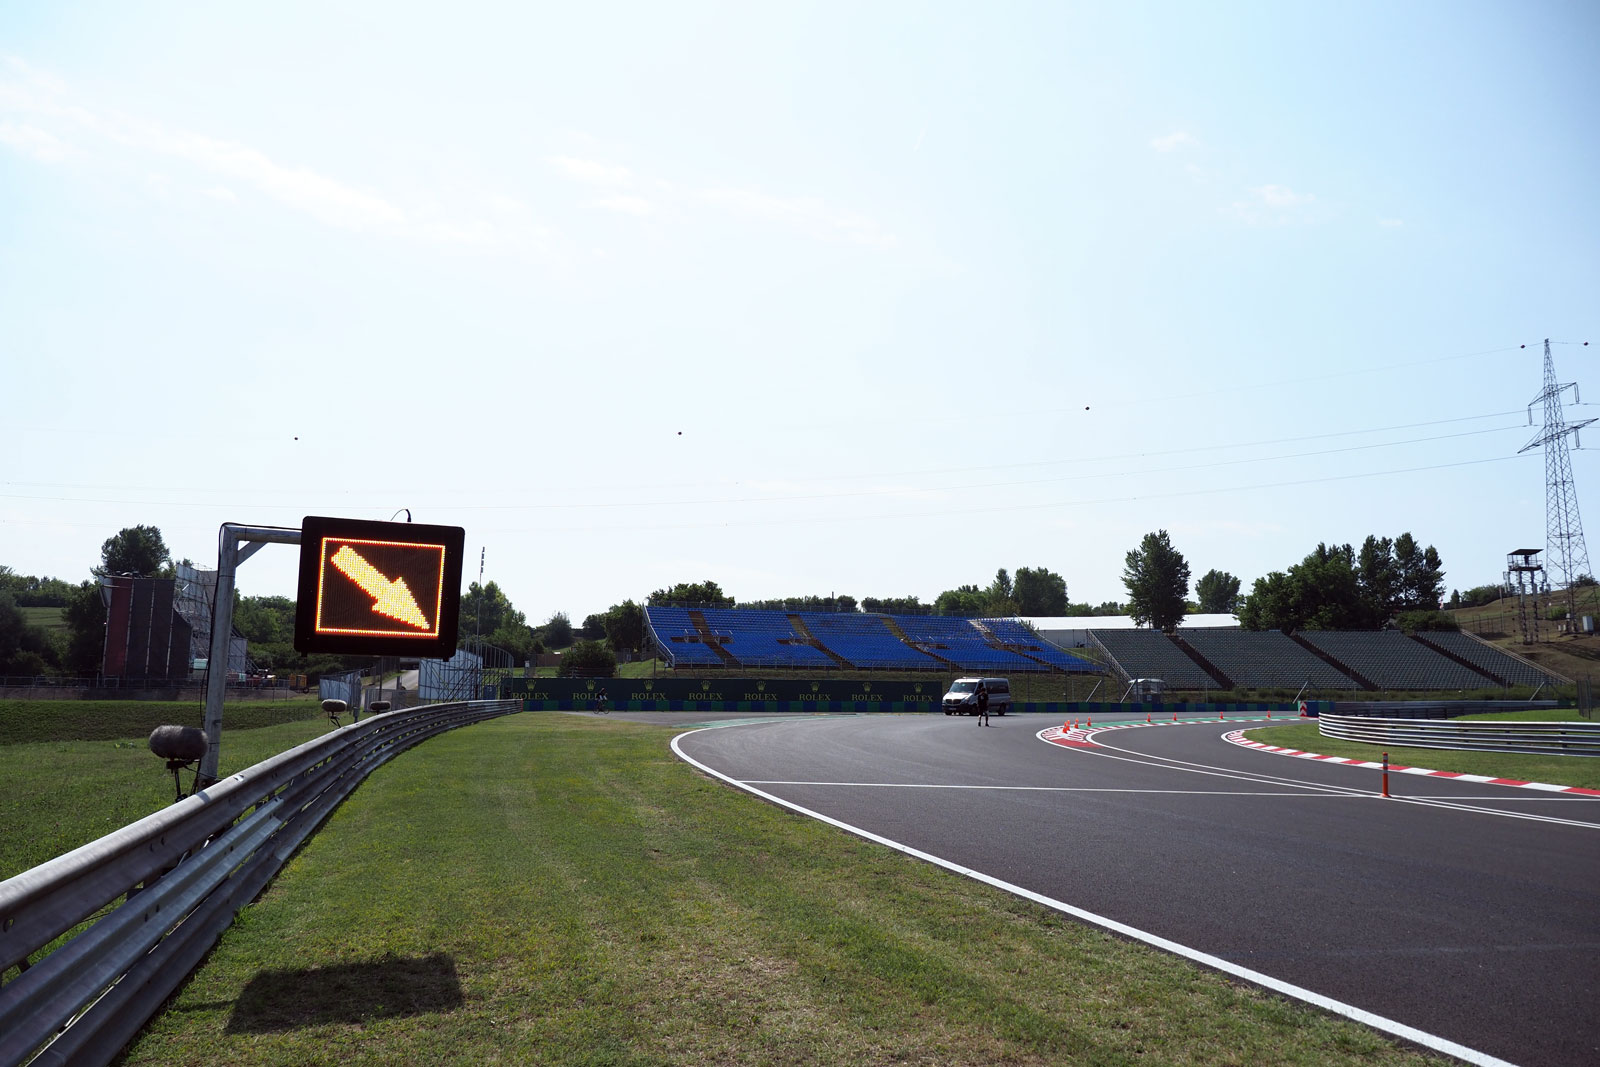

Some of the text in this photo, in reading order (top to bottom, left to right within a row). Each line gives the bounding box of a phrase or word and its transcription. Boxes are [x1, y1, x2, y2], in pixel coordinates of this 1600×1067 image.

[512, 692, 549, 700] ROLEX
[572, 692, 608, 700] ROL
[631, 692, 666, 700] ROLEX
[688, 692, 723, 700] ROLEX
[744, 693, 777, 701] ROLEX
[799, 693, 831, 701] ROLEX
[851, 694, 883, 702] ROLEX
[903, 694, 934, 702] ROLEX
